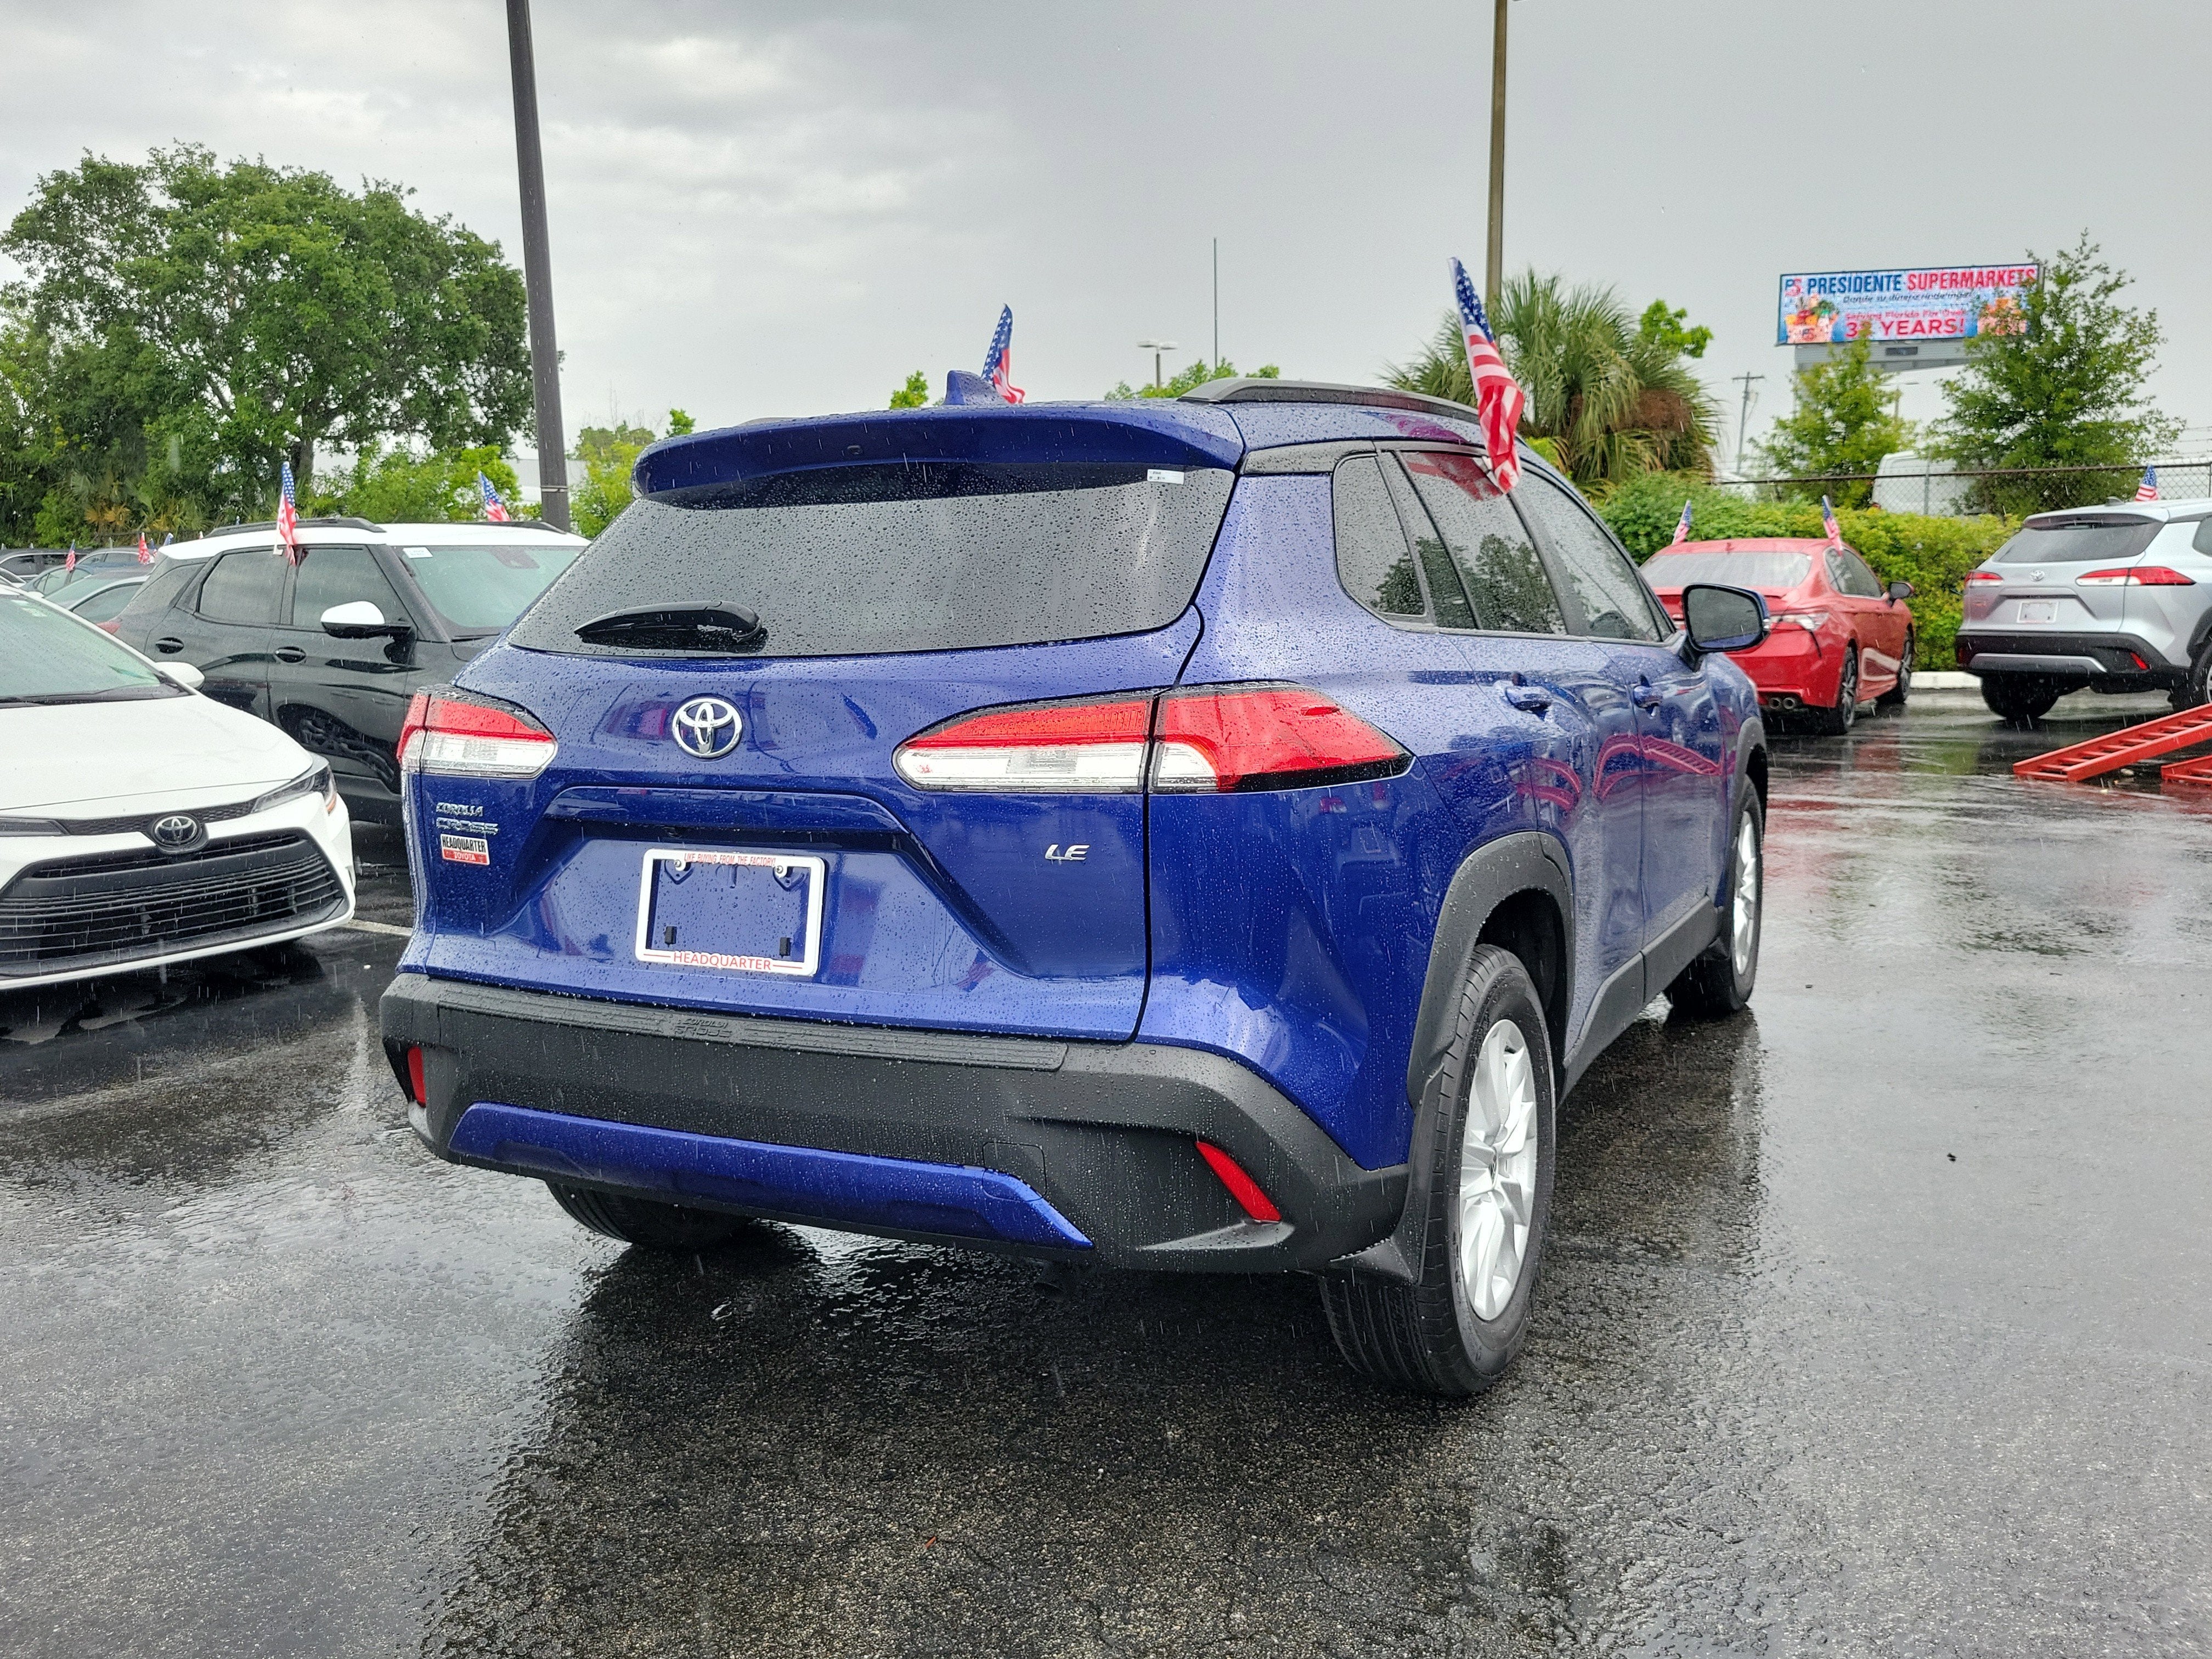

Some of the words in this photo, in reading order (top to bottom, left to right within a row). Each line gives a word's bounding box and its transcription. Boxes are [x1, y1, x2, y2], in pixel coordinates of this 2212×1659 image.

[1807, 274, 1901, 295] PRESIDENTE
[1908, 268, 2035, 290] SUPERMARKETS
[1845, 321, 1871, 338] 3
[1880, 318, 1965, 336] YEARS!
[436, 802, 484, 817] COROLLA
[436, 817, 499, 835] CROSS
[442, 836, 486, 853] HEADQUARTER
[1045, 844, 1090, 861] LE
[453, 852, 476, 861] TOYOTA
[684, 853, 696, 862] LIKE
[697, 854, 717, 862] BUYING
[720, 855, 735, 863] FROM
[738, 856, 748, 864] THE
[750, 856, 777, 866] FACTORY!
[674, 952, 771, 970] HEADQUARTER
[683, 1018, 729, 1029] COROLLA
